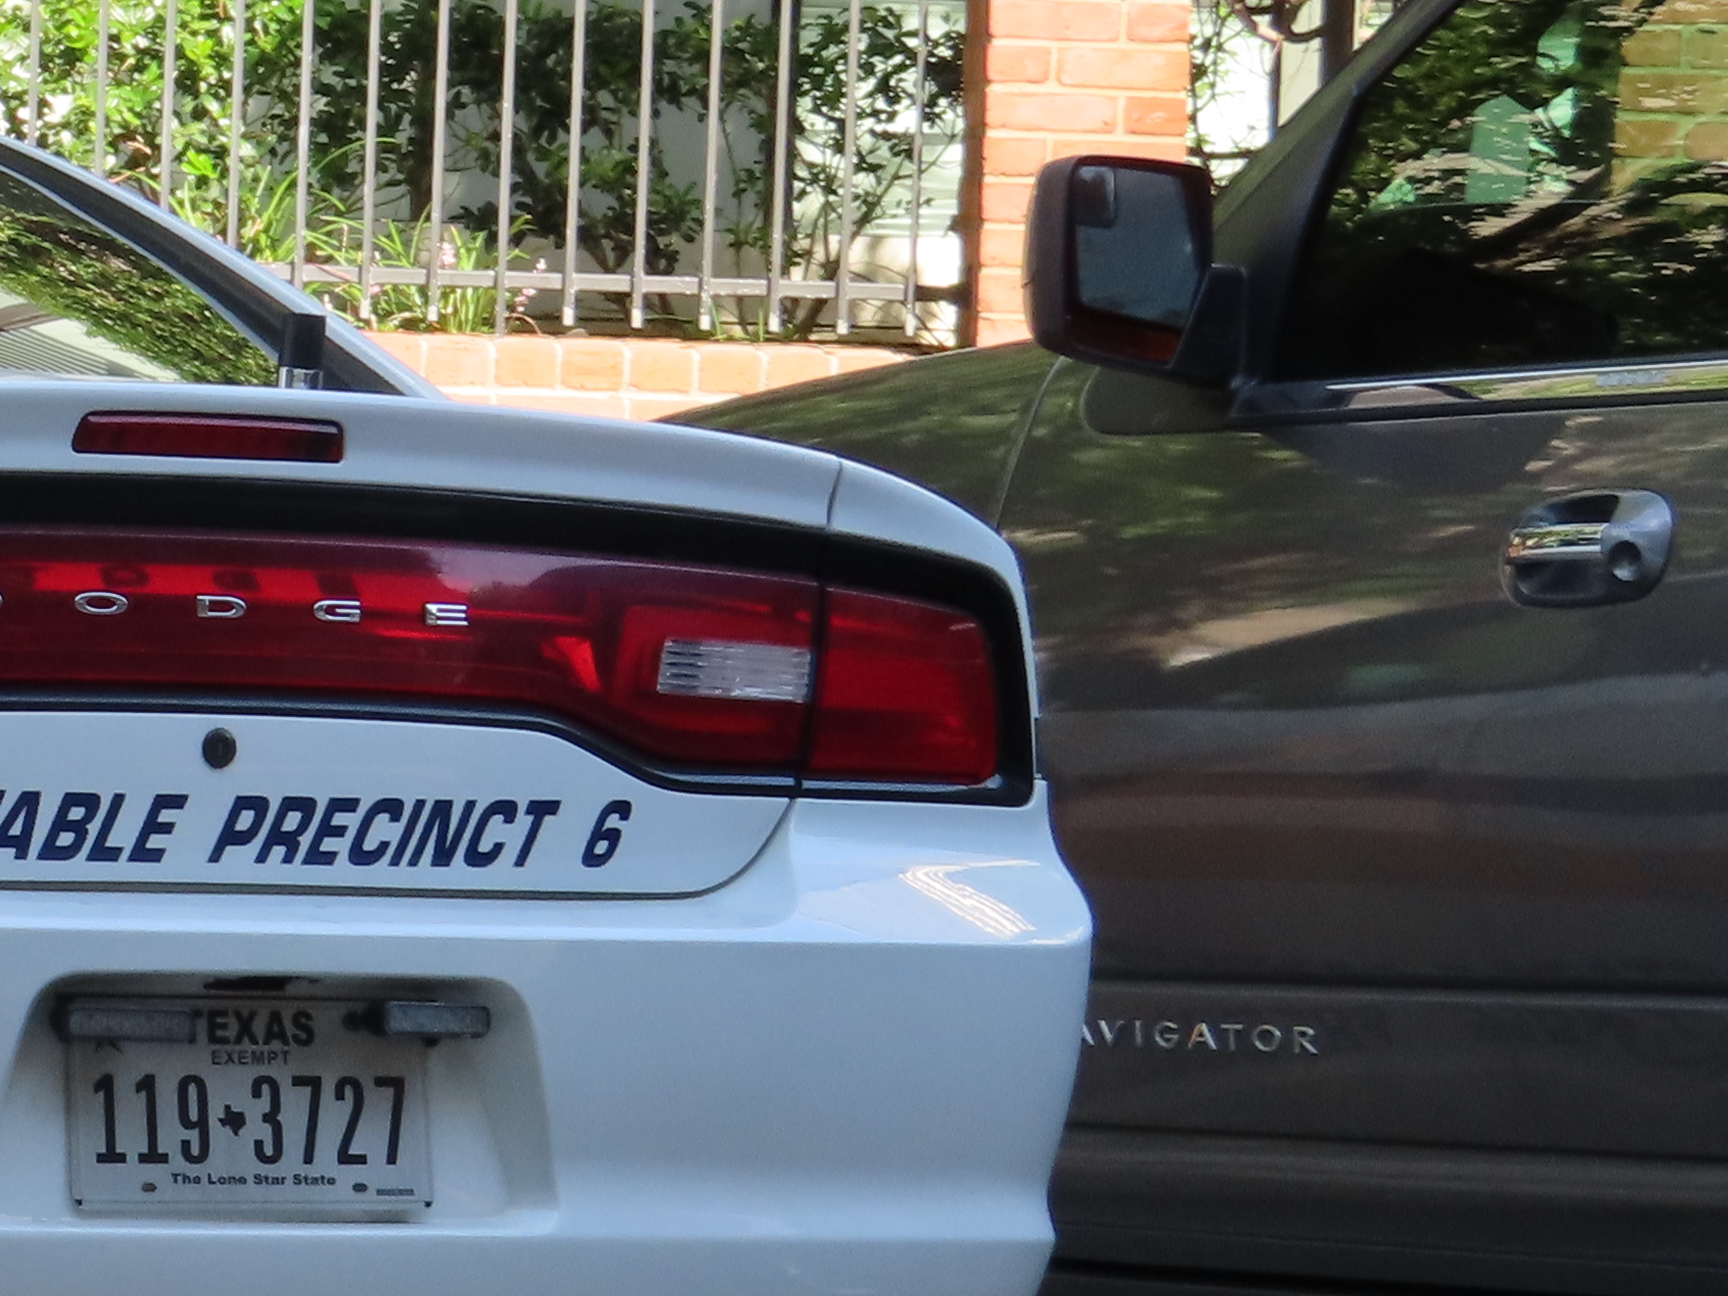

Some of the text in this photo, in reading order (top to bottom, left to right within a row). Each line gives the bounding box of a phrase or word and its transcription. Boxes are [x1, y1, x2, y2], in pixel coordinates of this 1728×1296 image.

[206, 794, 562, 868] PRECINCT
[581, 799, 633, 868] 6
[210, 1050, 292, 1066] EXEMPT
[93, 1073, 407, 1166] 119 3727
[170, 1172, 337, 1186] The Lone Star State
